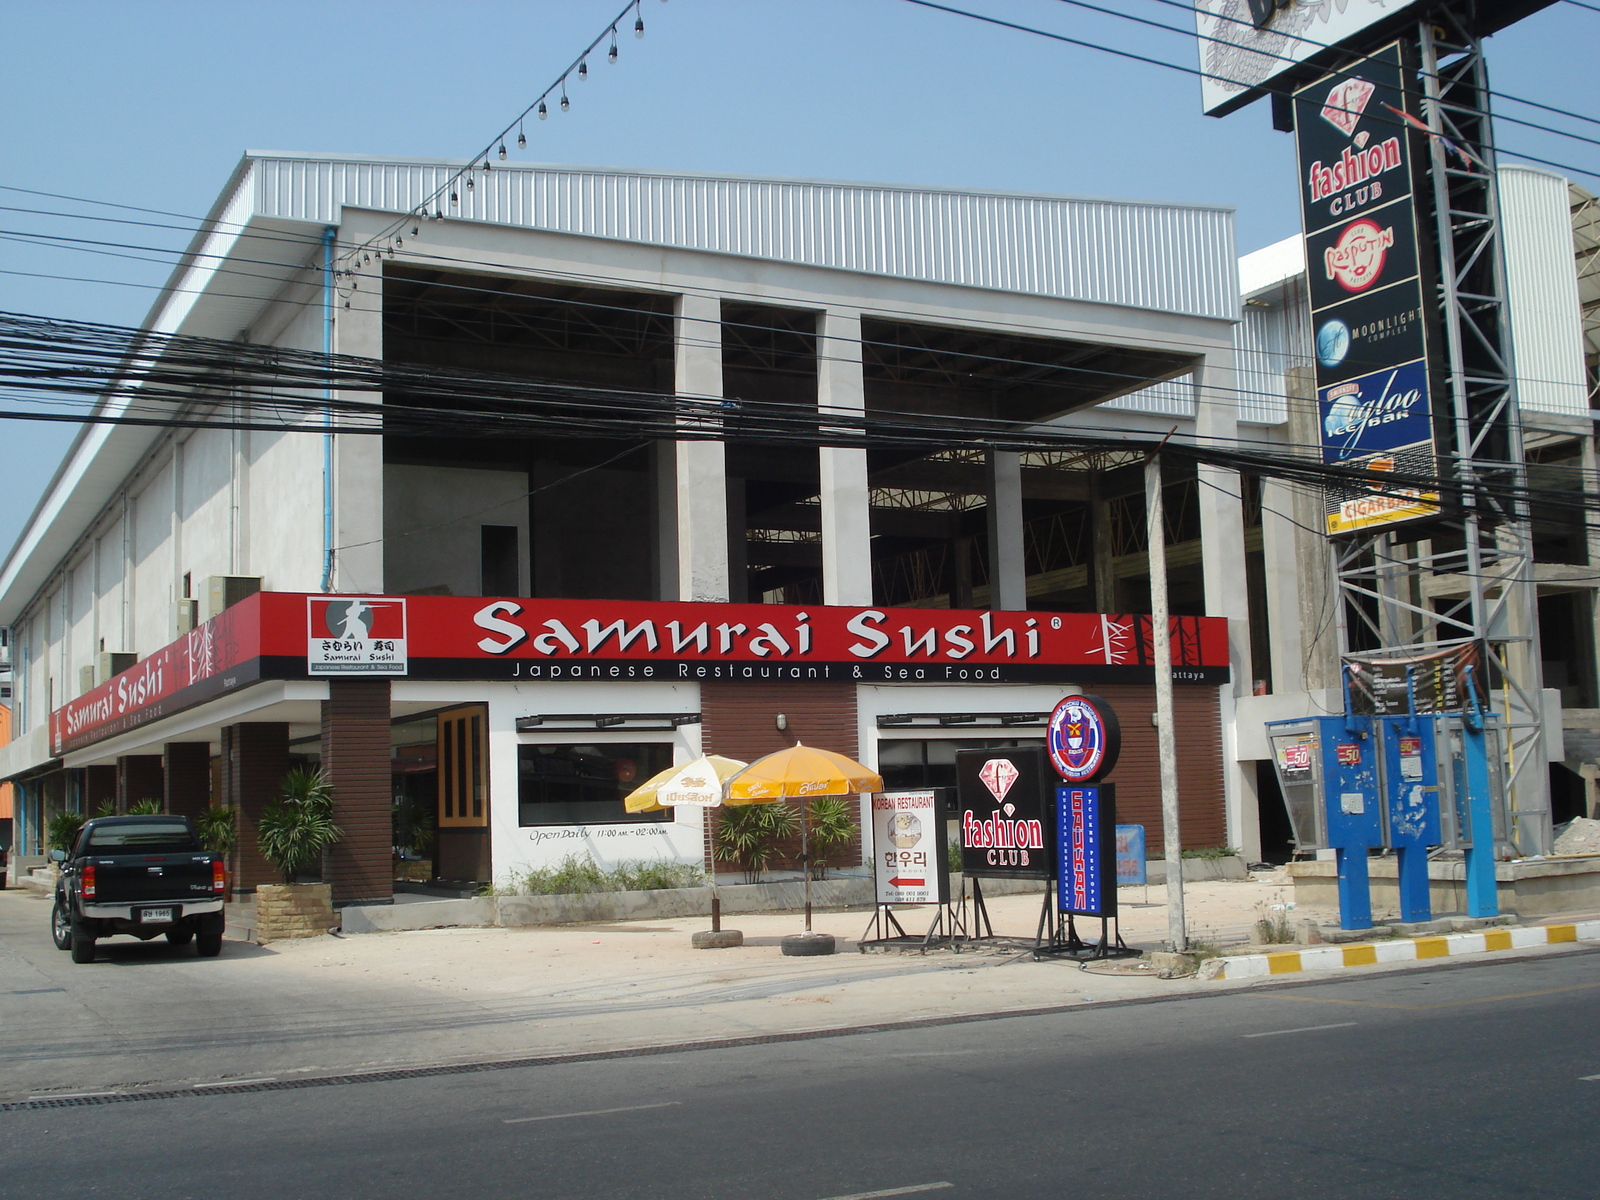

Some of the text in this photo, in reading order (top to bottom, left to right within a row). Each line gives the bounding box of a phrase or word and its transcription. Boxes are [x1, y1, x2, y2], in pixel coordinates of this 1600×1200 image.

[1308, 136, 1402, 204] fashion
[1330, 181, 1383, 216] CLUB
[1352, 308, 1422, 340] MOONLIGHT
[1368, 326, 1408, 343] COMPLEX
[473, 600, 813, 655] Samurai
[846, 610, 1039, 658] Sushi
[322, 640, 363, 651] さむらい
[324, 653, 394, 661] Samurai Sushi
[313, 664, 340, 672] Japanese
[513, 663, 1000, 681] Japanese Restaurant & Sea Food
[1172, 671, 1205, 681] attaya
[66, 685, 114, 735] Samurai
[117, 658, 163, 714] Sushi
[1294, 751, 1307, 764] 50
[1346, 749, 1359, 762] 50
[873, 796, 934, 810] KOREAN RESTAURANT
[529, 830, 560, 846] Open
[561, 826, 592, 843] Daily
[597, 829, 617, 838] 11:00
[635, 828, 658, 836] 02:00
[963, 809, 1044, 848] fashion
[885, 851, 927, 868] 한우리
[986, 849, 1030, 867] CLUB
